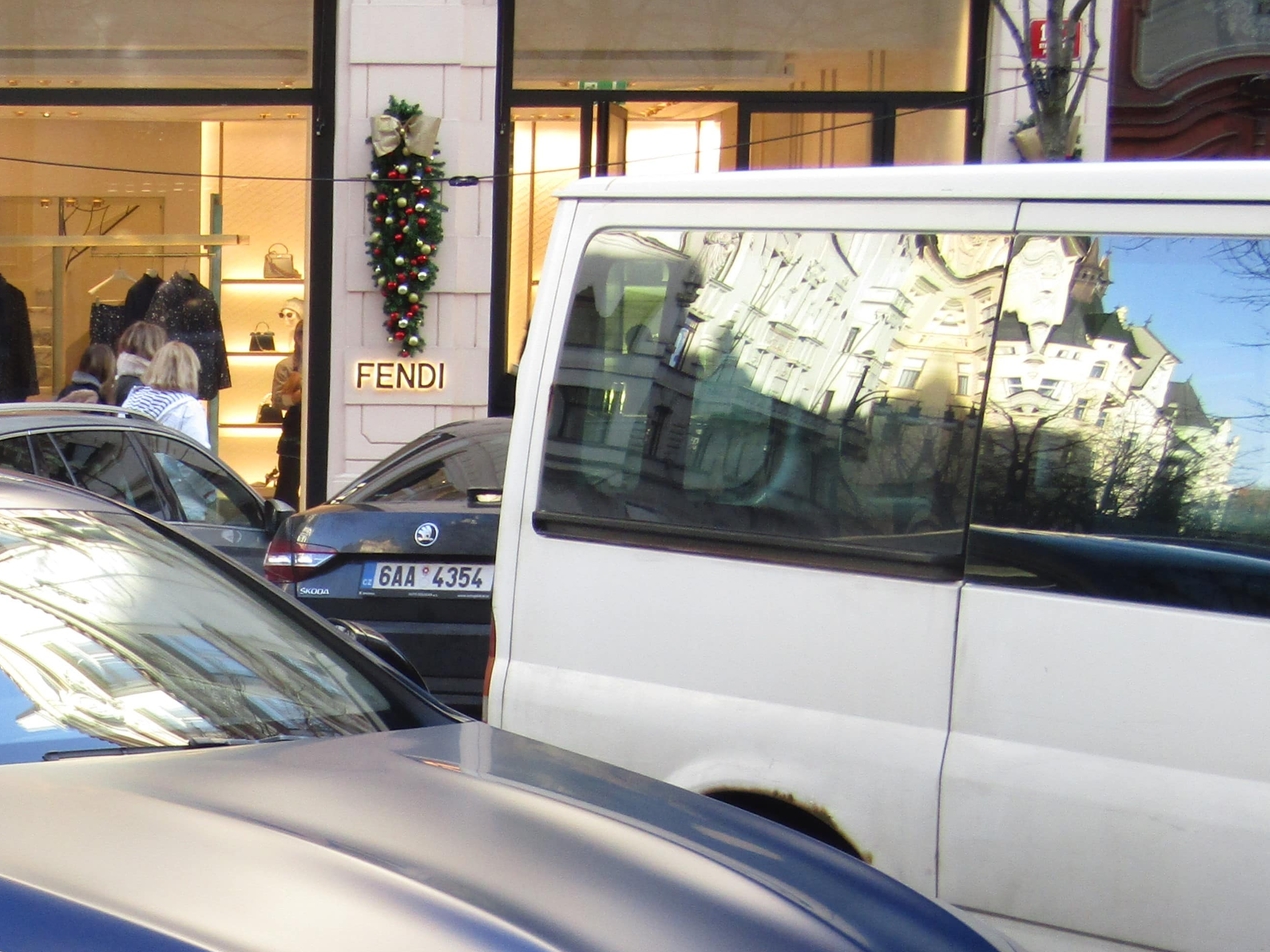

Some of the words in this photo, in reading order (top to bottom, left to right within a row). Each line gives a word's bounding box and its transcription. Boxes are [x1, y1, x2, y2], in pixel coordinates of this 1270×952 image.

[356, 362, 445, 389] FENDI
[362, 578, 372, 586] CZ
[379, 565, 416, 587] 6AA
[432, 566, 483, 588] 4354
